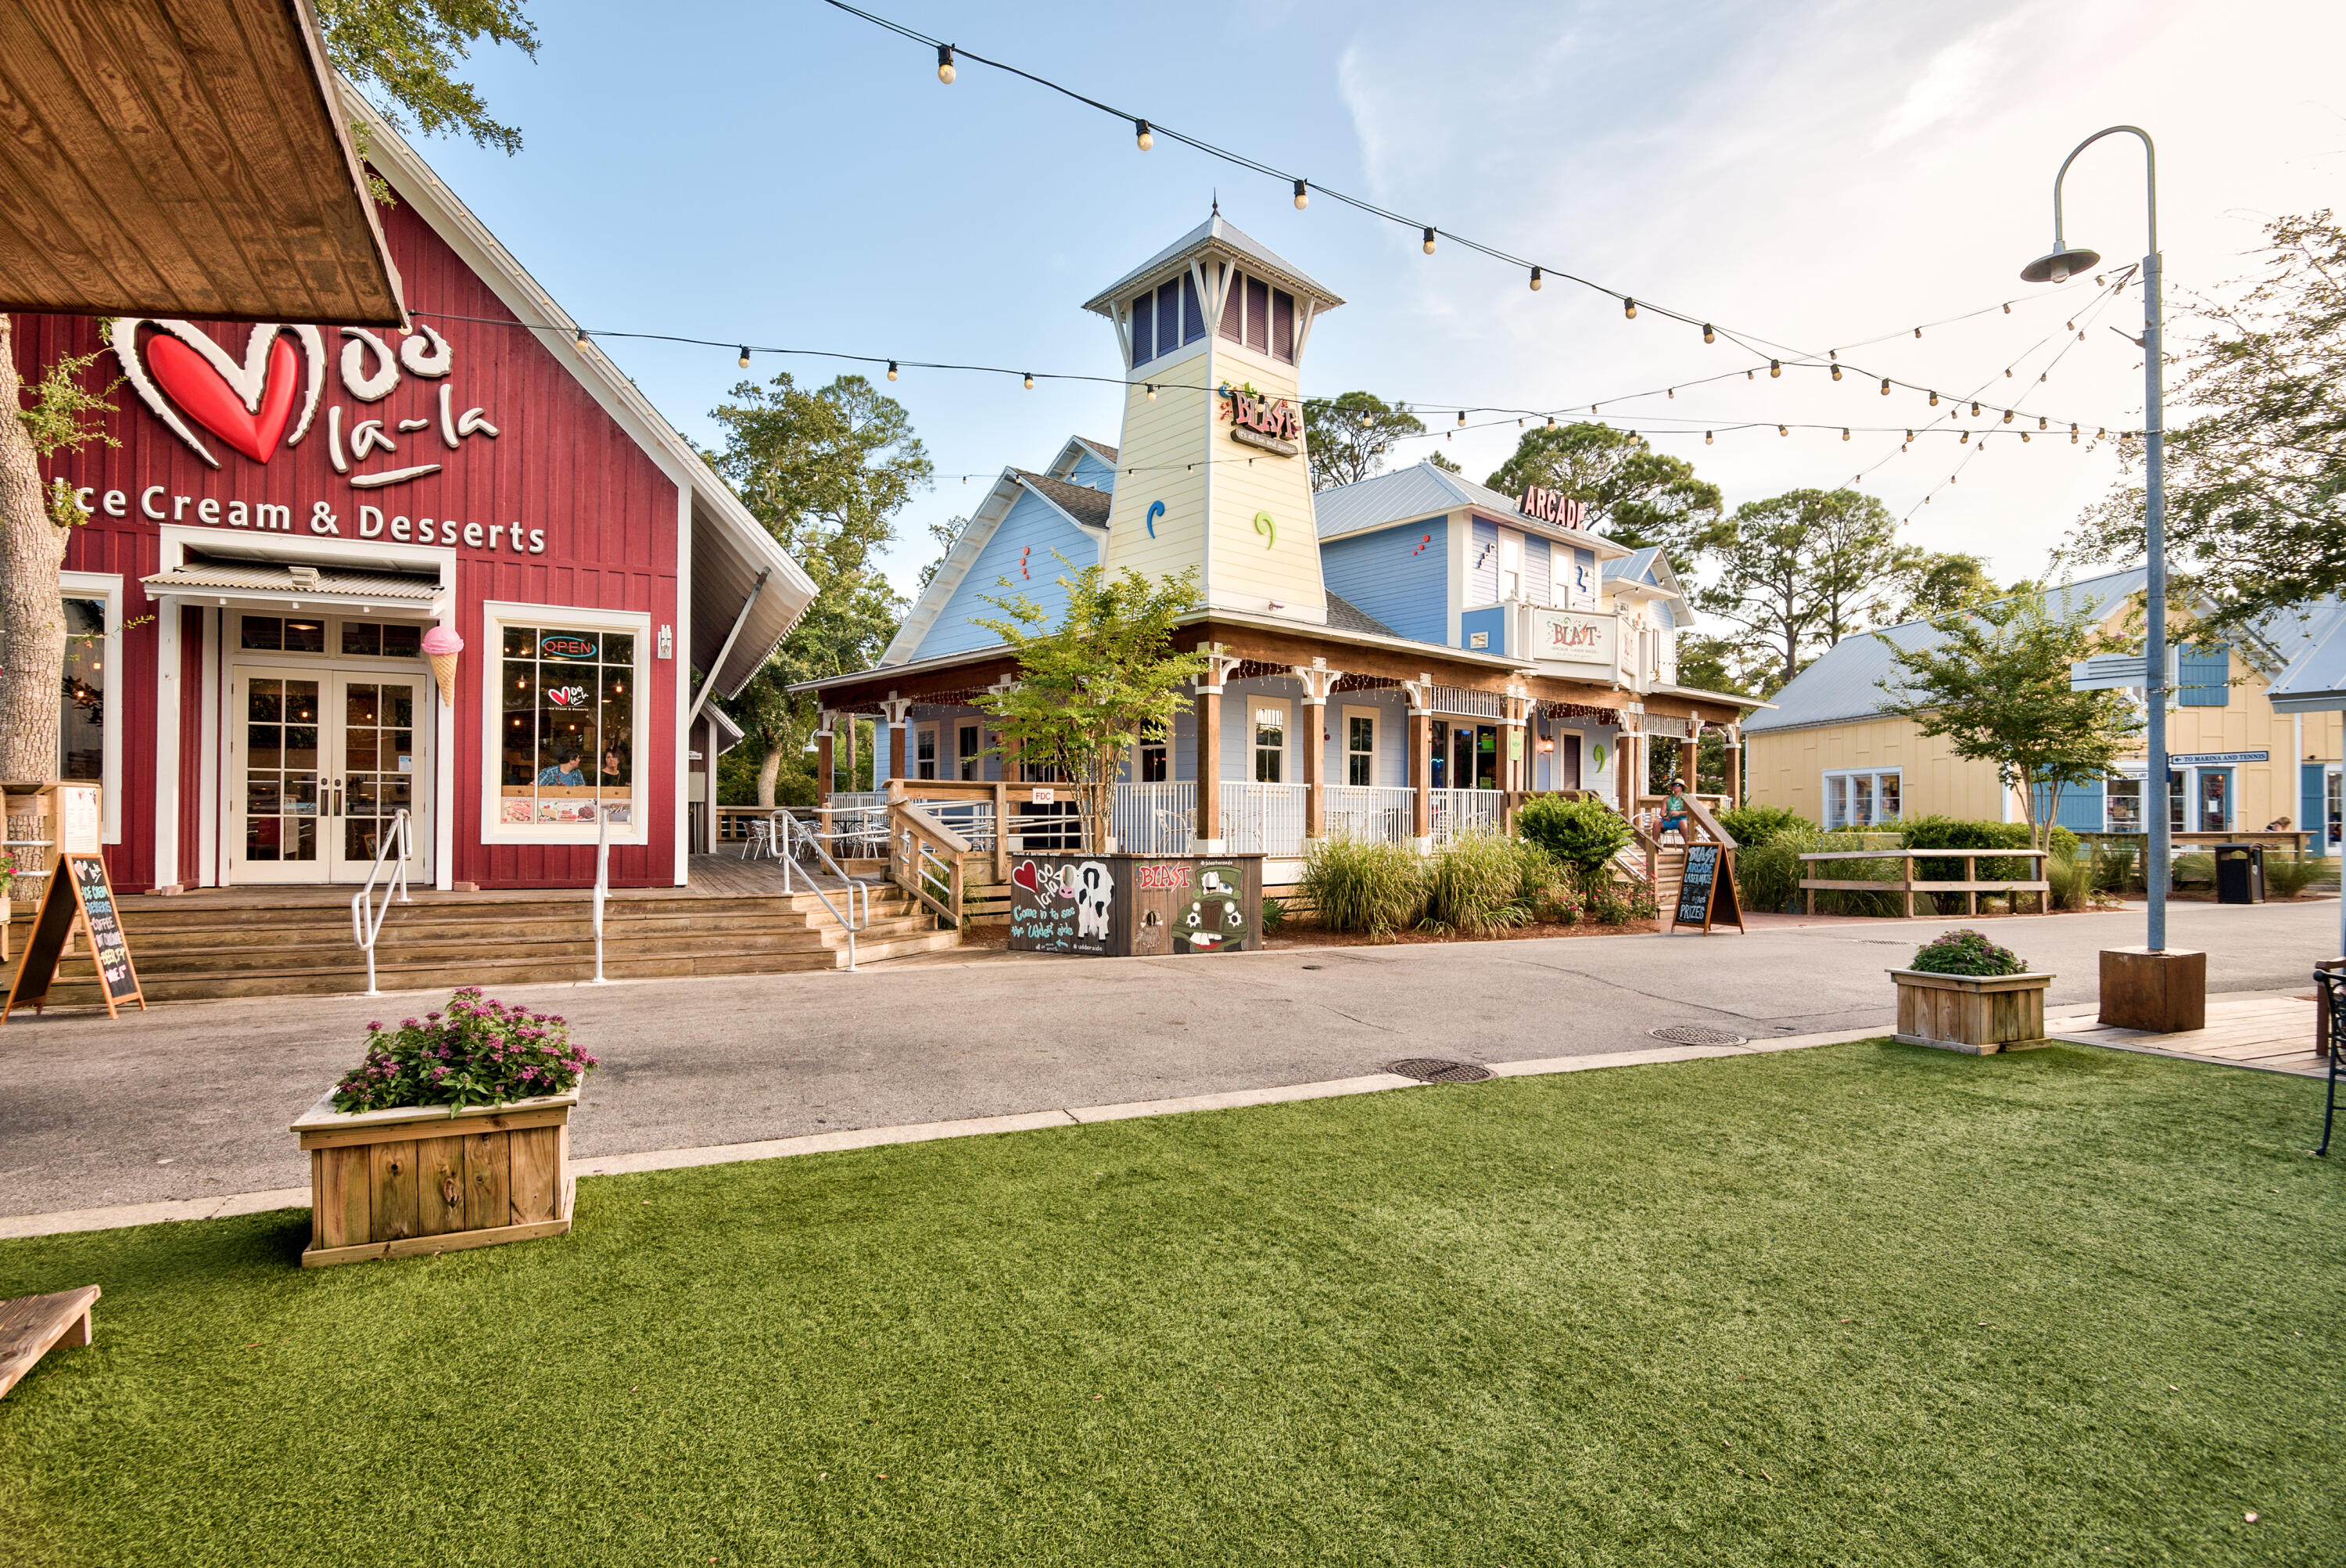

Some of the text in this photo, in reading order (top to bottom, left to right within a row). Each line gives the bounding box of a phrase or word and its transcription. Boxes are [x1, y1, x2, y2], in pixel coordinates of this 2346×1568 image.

[1233, 390, 1297, 440] BLAST
[1238, 429, 1247, 438] It's
[1256, 435, 1265, 444] fun
[1524, 484, 1586, 532] ARCADE
[141, 485, 292, 533] Cream
[311, 501, 339, 536] &
[360, 505, 546, 553] Desserts
[1552, 620, 1597, 647] BLAST
[544, 640, 590, 654] OPEN
[1688, 846, 1719, 864] BLAST
[1687, 863, 1713, 874] ARCADE
[1139, 862, 1191, 893] BLAST
[1013, 905, 1075, 921] Come in to see
[1680, 904, 1706, 920] PRIZES
[1011, 925, 1024, 938] the
[1057, 922, 1074, 937] side
